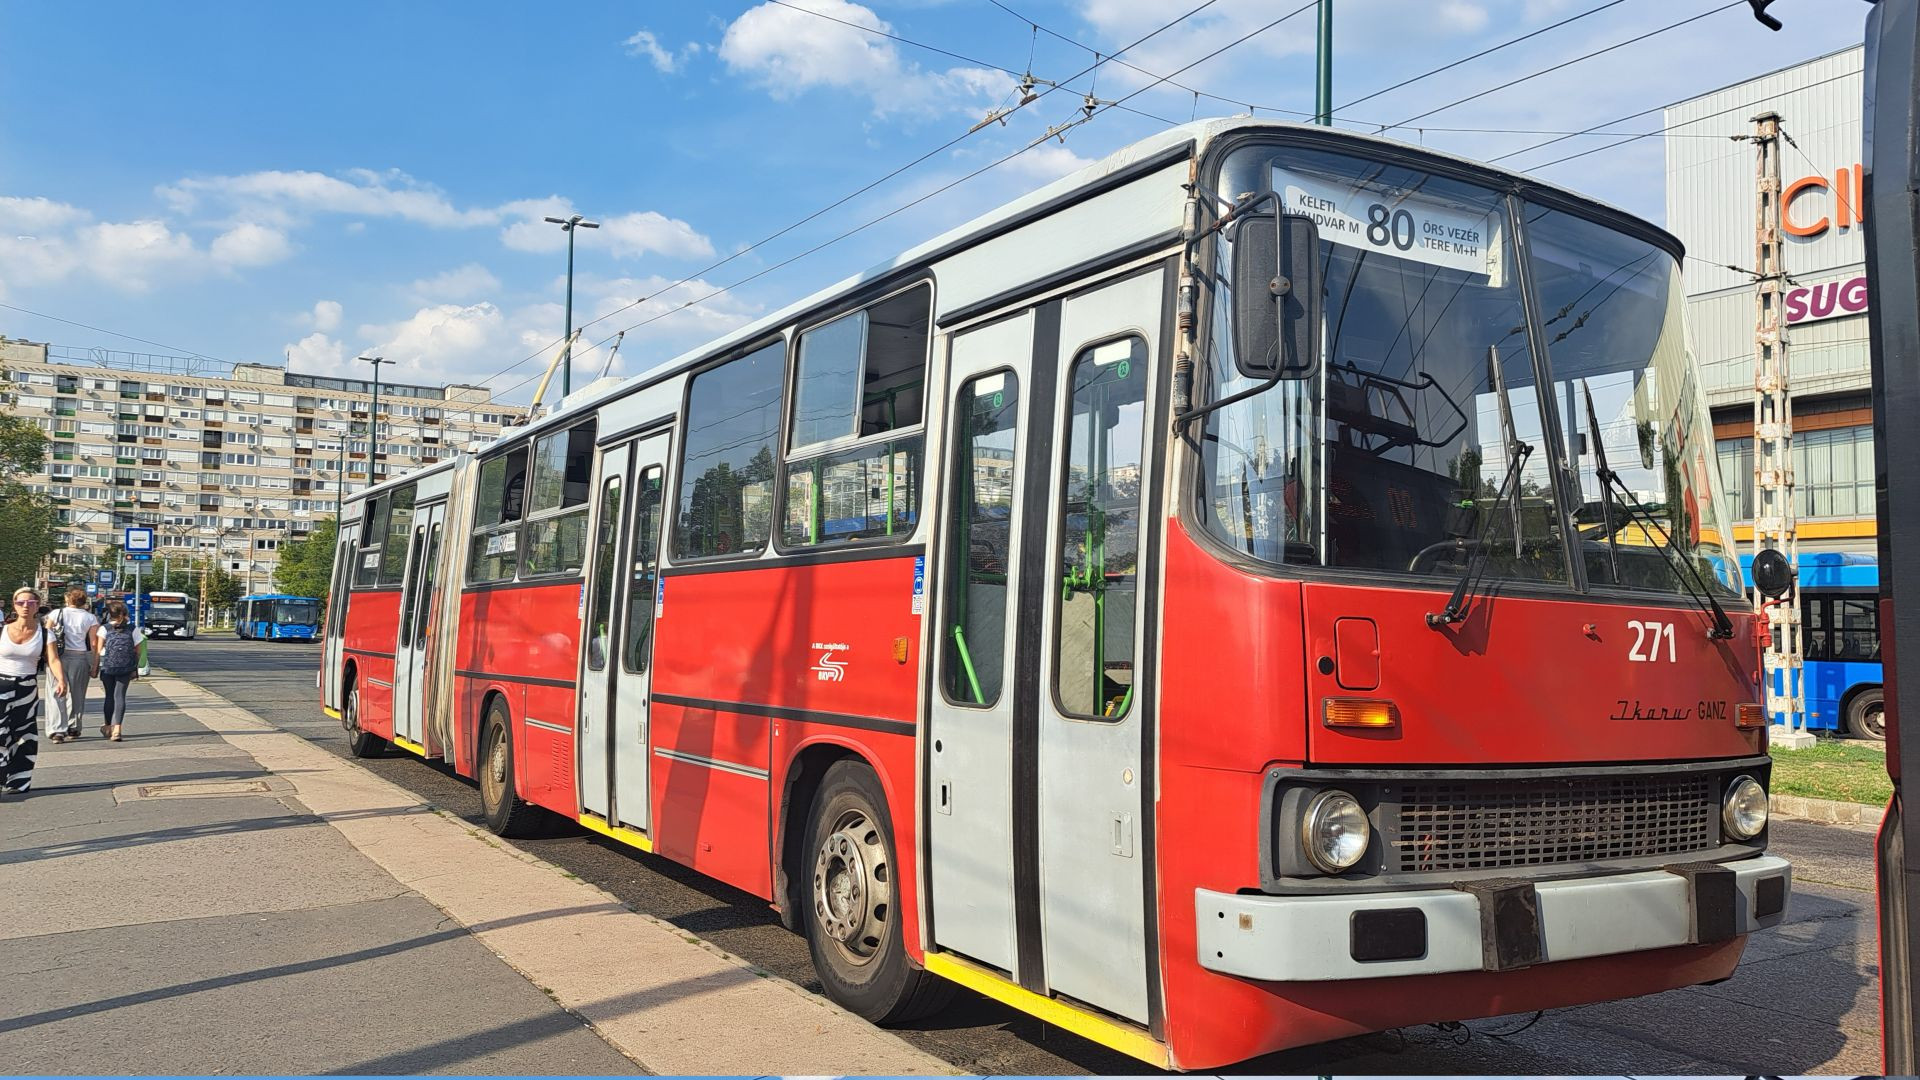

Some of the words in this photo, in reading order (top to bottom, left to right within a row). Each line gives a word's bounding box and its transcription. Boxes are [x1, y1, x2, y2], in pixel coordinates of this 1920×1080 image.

[1300, 194, 1335, 212] KELETI
[1349, 221, 1359, 234] M
[1367, 204, 1415, 251] 80
[1447, 225, 1479, 243] VEZÉR
[1424, 237, 1450, 252] TERE
[1454, 242, 1477, 257] M+H
[1627, 621, 1676, 662] 271
[1610, 701, 1692, 720] Ikarus
[1698, 701, 1726, 720] GANZ
